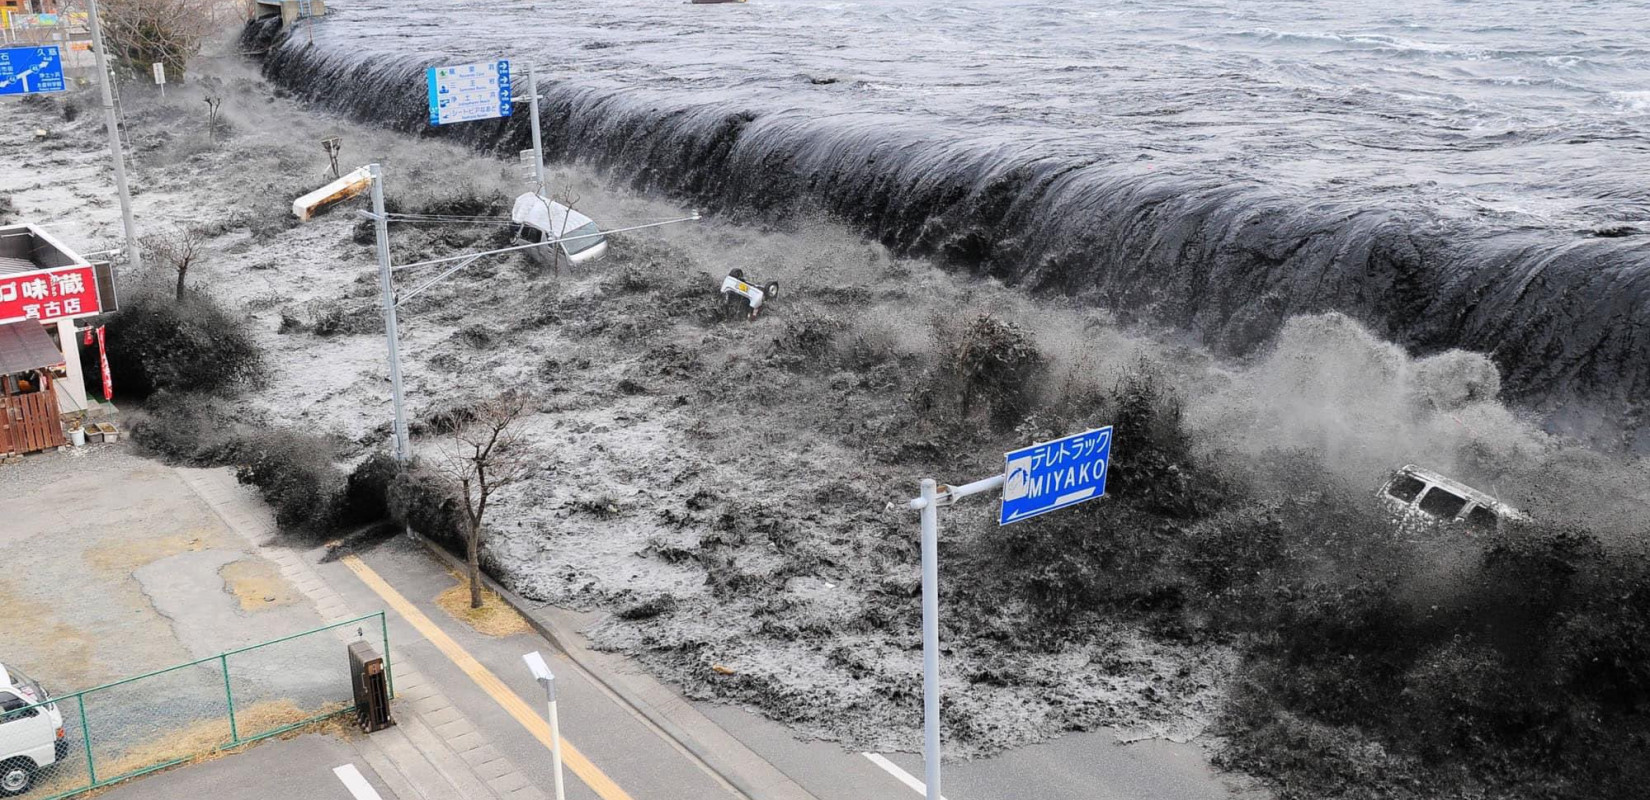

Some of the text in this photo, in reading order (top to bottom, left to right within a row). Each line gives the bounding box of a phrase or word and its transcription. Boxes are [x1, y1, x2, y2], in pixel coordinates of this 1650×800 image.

[22, 298, 82, 319] 宮古店
[1032, 431, 1110, 471] テレトラック
[1028, 458, 1105, 499] MIYAKO
